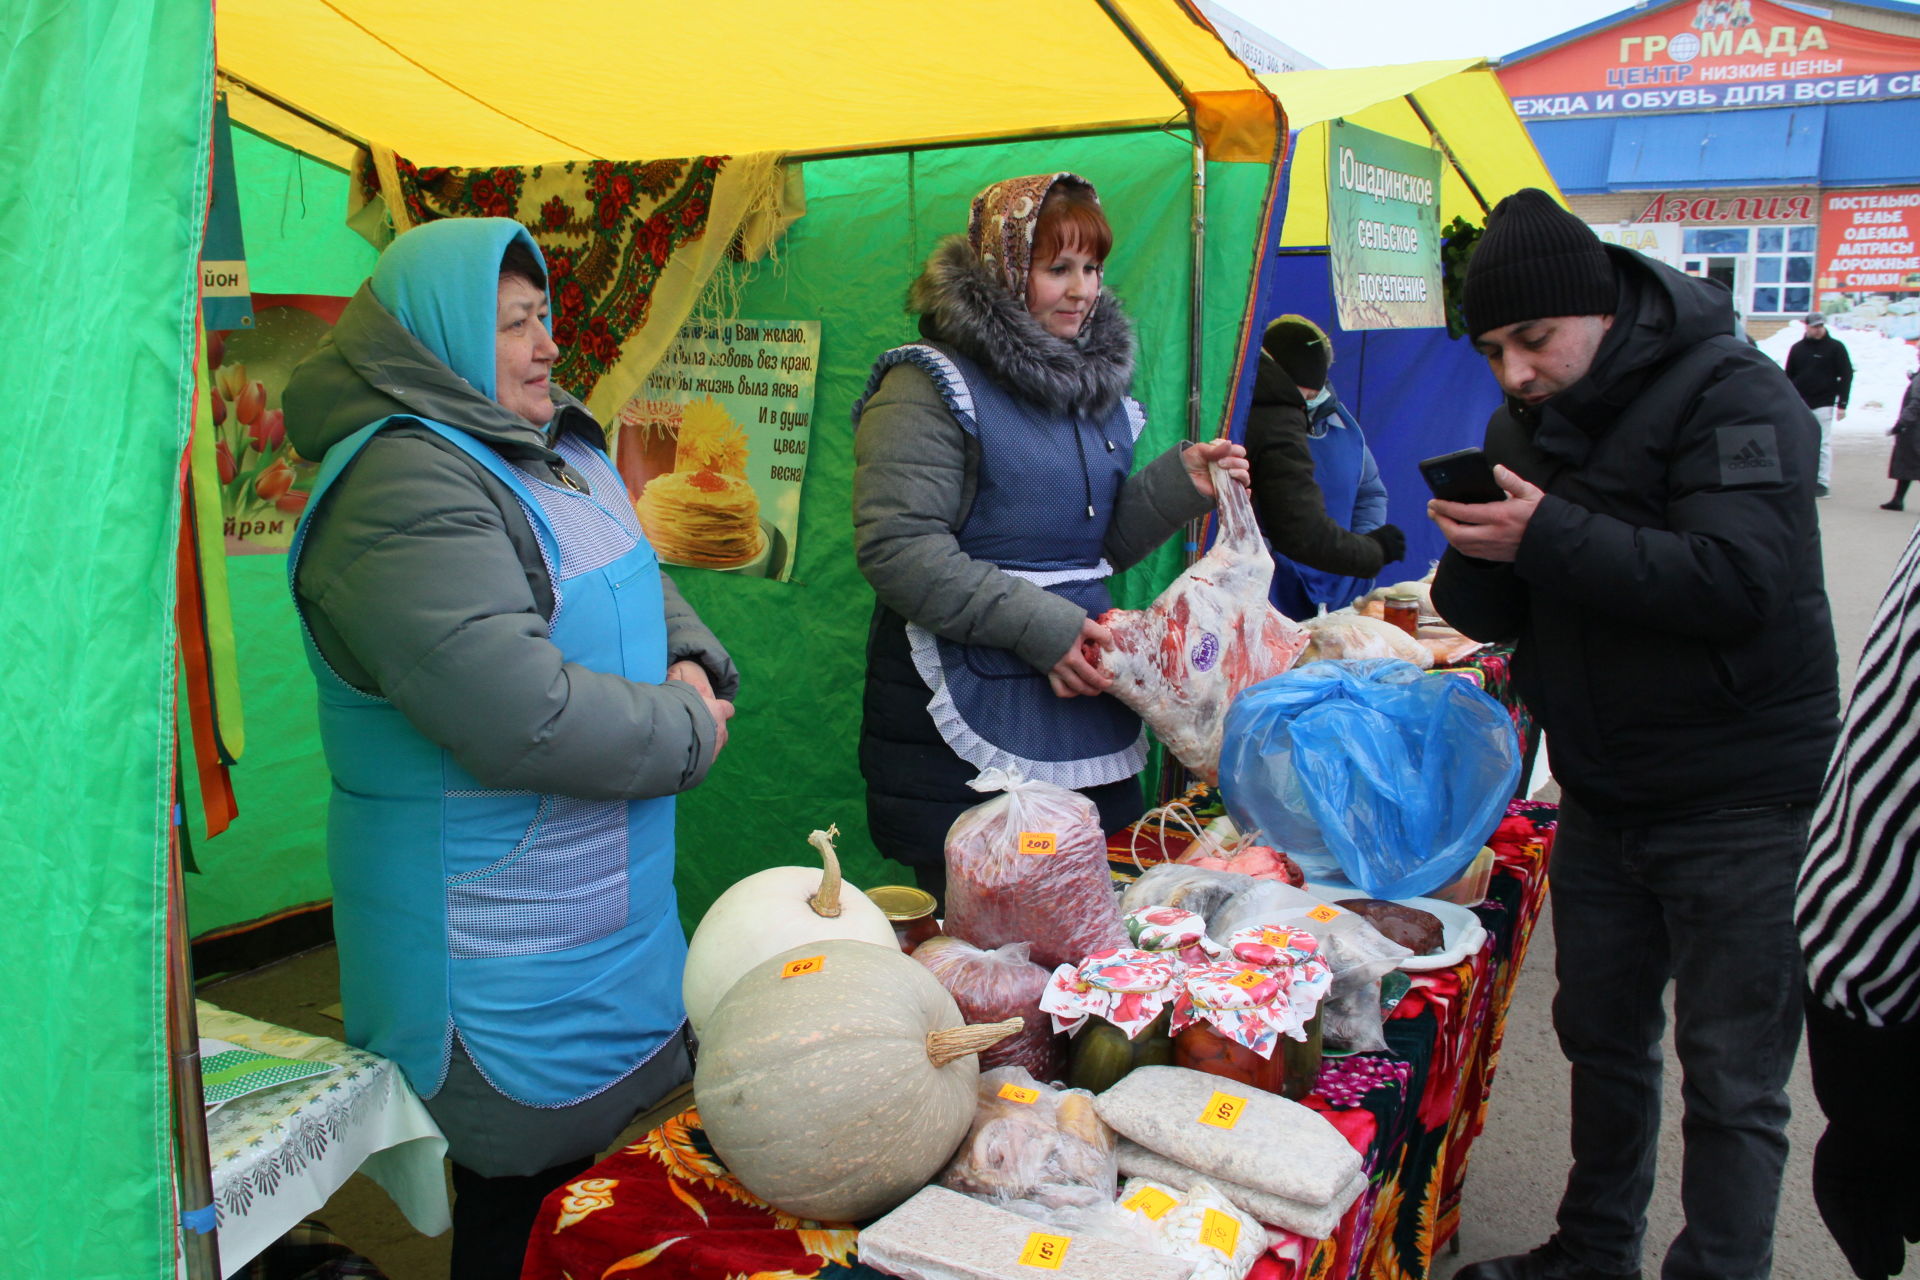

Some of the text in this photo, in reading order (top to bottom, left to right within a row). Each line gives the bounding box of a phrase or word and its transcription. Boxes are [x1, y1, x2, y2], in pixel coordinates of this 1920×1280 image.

[1619, 26, 1830, 63] ГРОМАДА
[1607, 59, 1844, 88] ЦЕНТР НИЗКИЕ ЦЕНЫ
[1596, 94, 1614, 111] И
[1621, 88, 1717, 109] ОБУВЬ
[1723, 84, 1786, 106] ДЛЯ
[1794, 75, 1879, 99] ВСЕЙ
[1338, 146, 1433, 206] Юшадинское
[1636, 193, 1812, 223] Азалия
[1853, 210, 1903, 225] БЕЛЬЕ
[1358, 218, 1418, 254] сельское
[1844, 226, 1909, 240] ОДЕЯЛА
[1837, 242, 1915, 256] МАТРАСЫ
[1828, 256, 1920, 272] ДОРОЖНЫЕ
[204, 269, 239, 288] йон
[1358, 273, 1427, 303] поселение
[1846, 273, 1900, 286] СУМКИ
[735, 324, 760, 342] Вам
[757, 348, 778, 370] без
[695, 377, 735, 395] жизнь
[738, 375, 768, 396] была
[771, 382, 799, 399] ясна
[758, 406, 809, 432] И в душе
[773, 438, 806, 456] цвела
[1026, 839, 1051, 850] 200
[792, 961, 813, 972] 60
[1215, 1102, 1234, 1121] 150
[1038, 1241, 1055, 1260] 150
